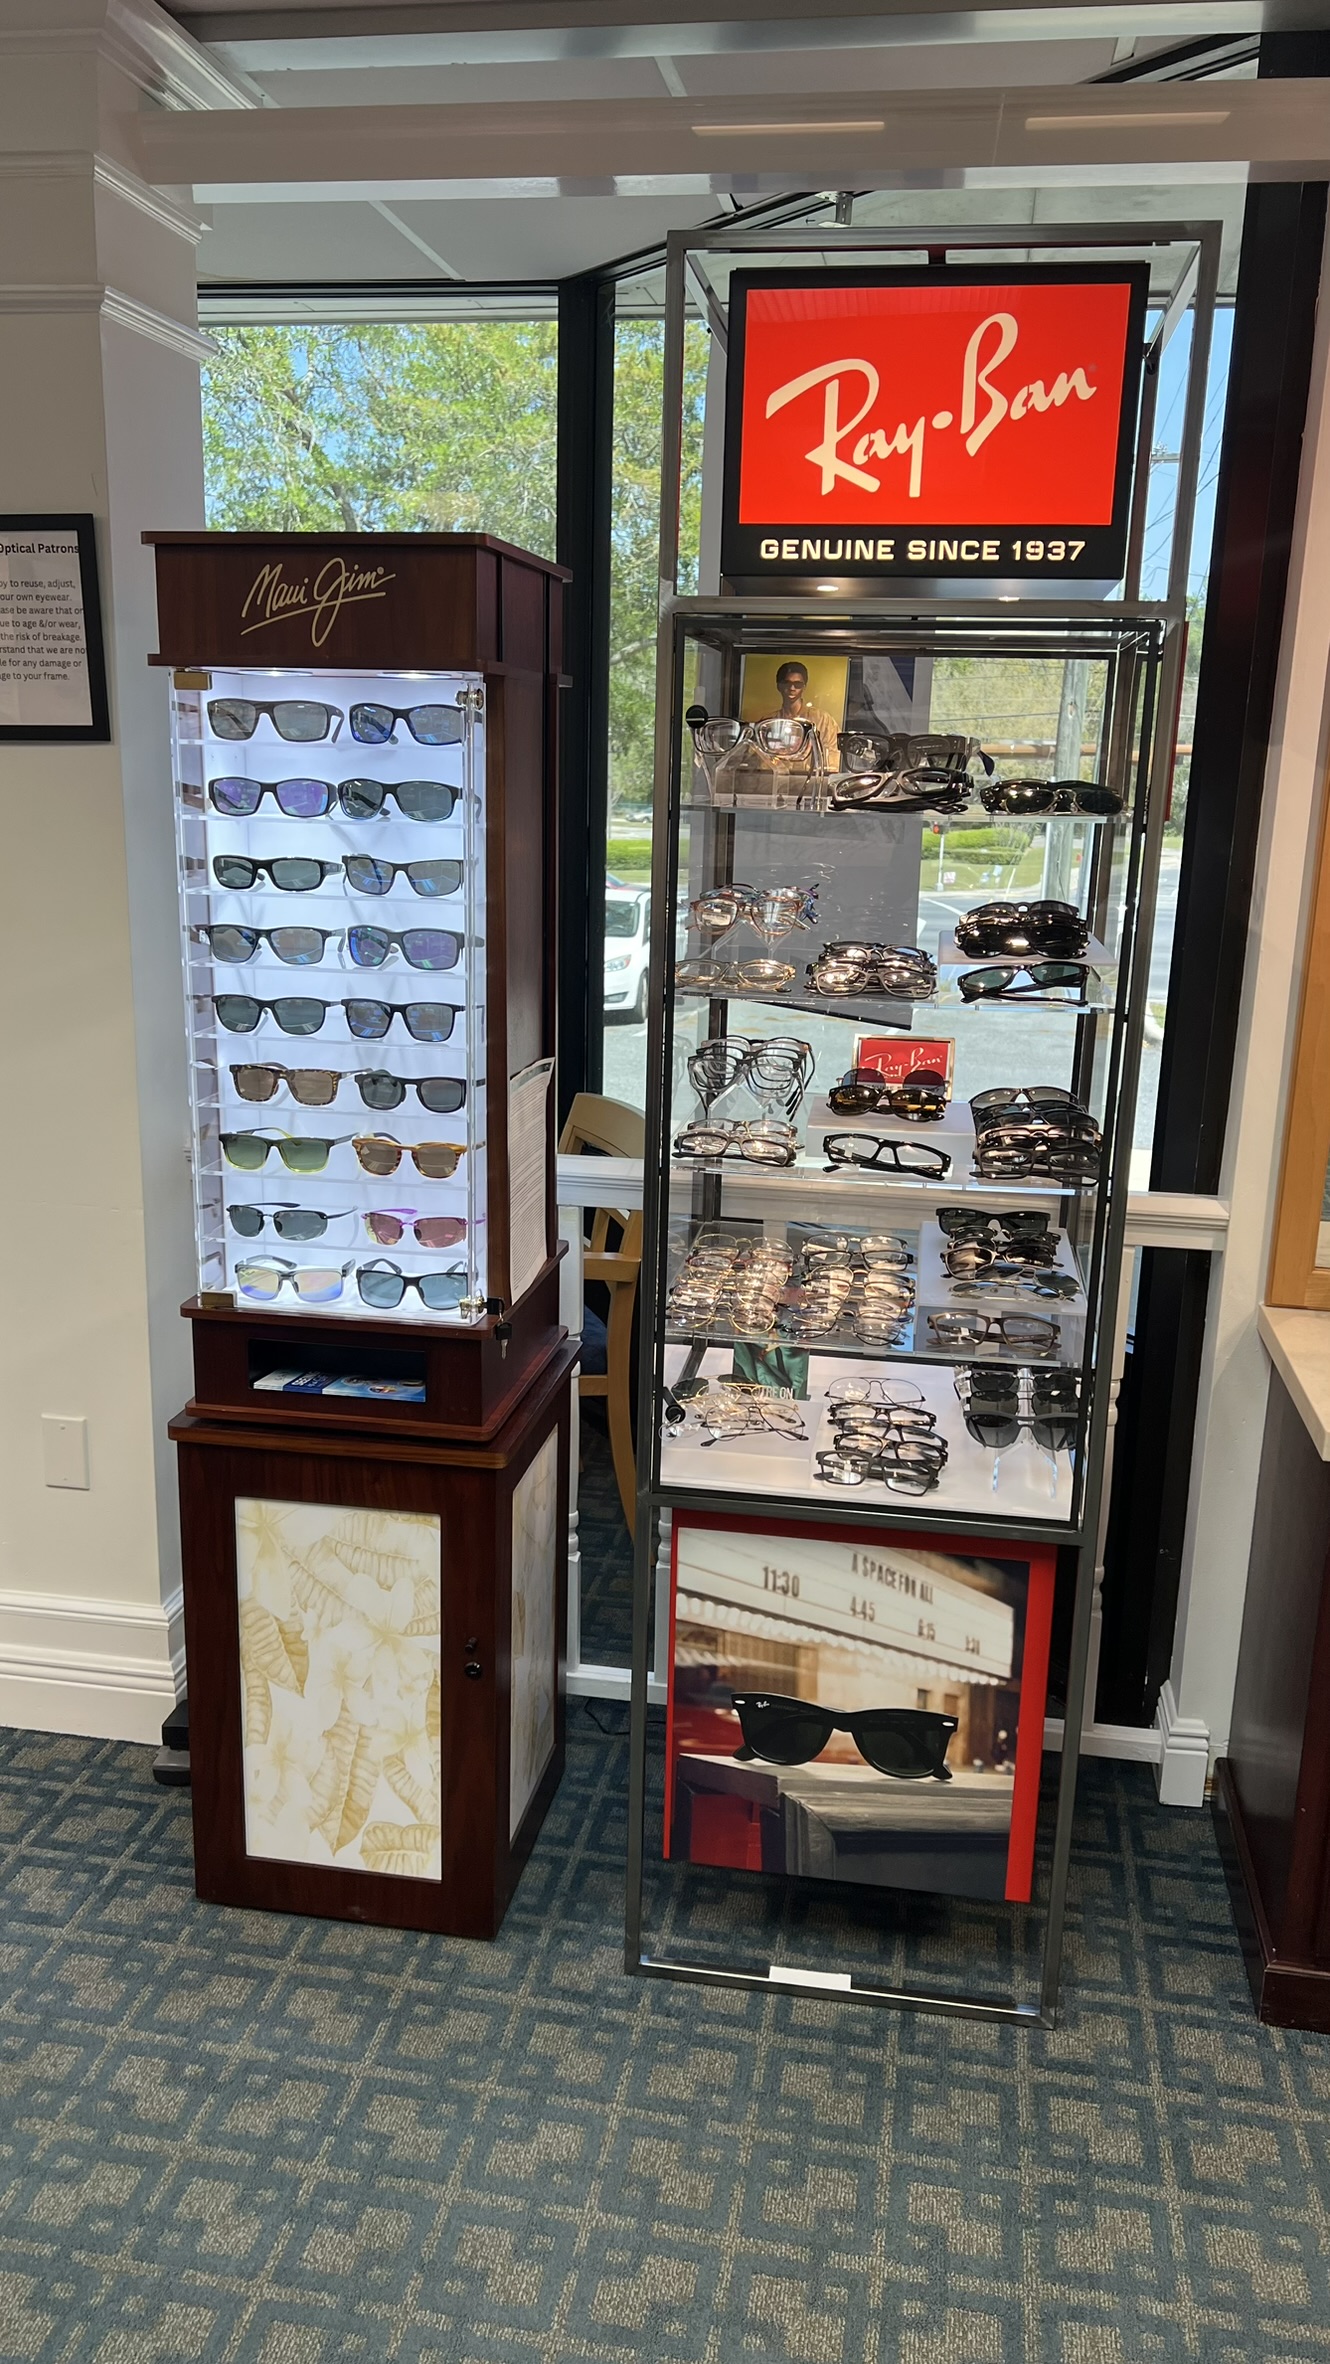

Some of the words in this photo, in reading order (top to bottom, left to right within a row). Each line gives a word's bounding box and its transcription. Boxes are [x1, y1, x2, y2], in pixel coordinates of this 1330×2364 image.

[38, 543, 80, 554] Patrons
[759, 538, 895, 561] GENUINE
[906, 539, 1001, 562] SINCE
[1011, 539, 1087, 562] 1937
[10, 580, 19, 588] to
[21, 581, 46, 589] reuse,
[47, 579, 76, 589] adjust,
[35, 594, 72, 603] eyewear.
[240, 563, 309, 619] Maui
[312, 557, 396, 647] Jim
[16, 606, 27, 614] be
[55, 606, 73, 614] that
[12, 620, 20, 628] to
[22, 621, 37, 629] age
[58, 621, 81, 629] wear,
[0, 632, 14, 640] the
[16, 632, 31, 640] risk
[32, 632, 41, 640] of
[27, 646, 45, 654] that
[75, 647, 87, 655] no
[9, 658, 21, 666] for
[22, 660, 37, 669] any
[39, 659, 71, 669] damage
[13, 672, 21, 680] to
[23, 673, 42, 682] your
[43, 672, 70, 680] frame.
[851, 1553, 859, 1575] A
[862, 1555, 897, 1590] SPACE
[762, 1566, 800, 1598] 11:30
